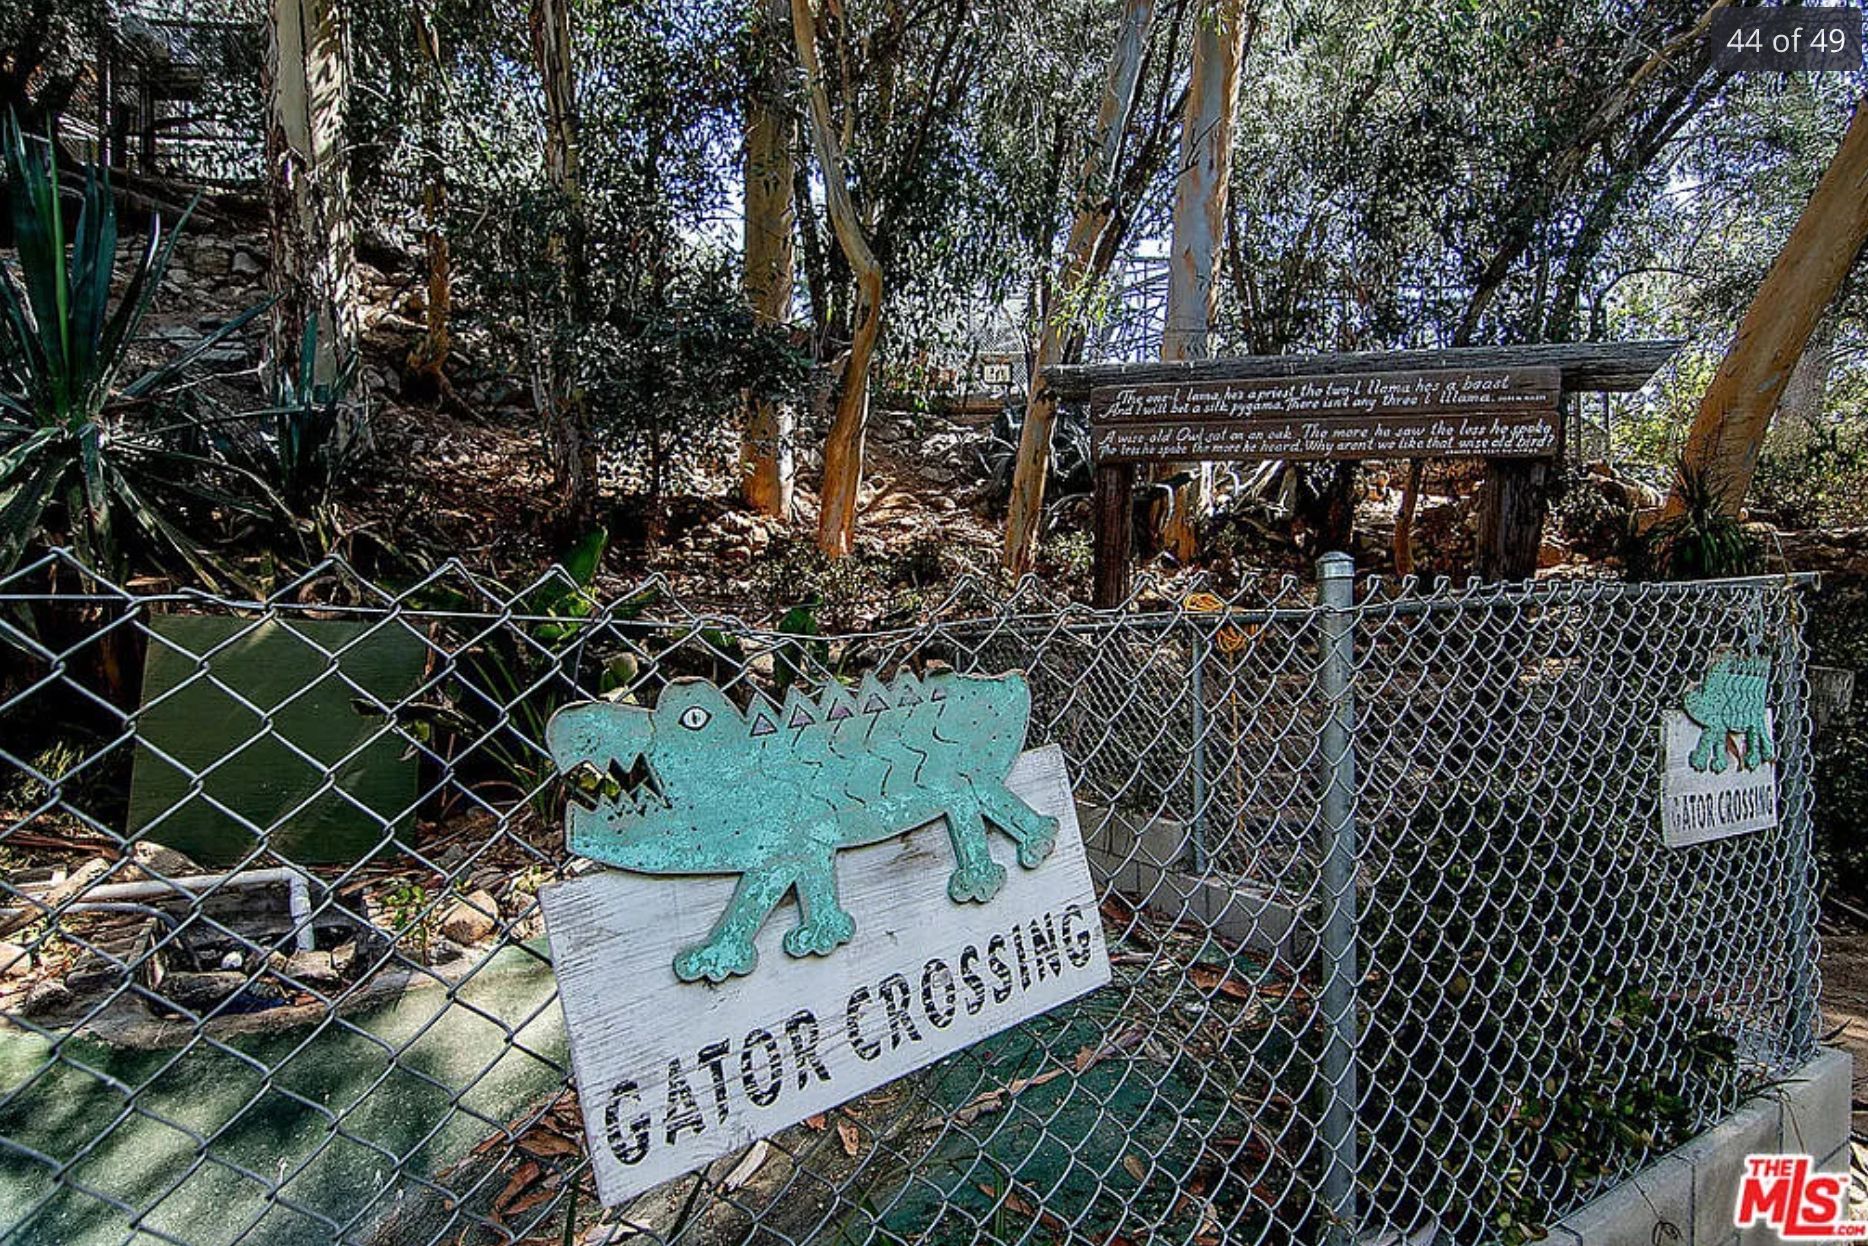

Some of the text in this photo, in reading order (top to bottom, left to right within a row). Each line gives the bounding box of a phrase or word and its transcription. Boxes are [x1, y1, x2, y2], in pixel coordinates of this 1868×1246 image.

[1116, 389, 1144, 404] The
[1300, 383, 1323, 398] the
[1367, 379, 1411, 396] llama
[1446, 382, 1458, 391] a
[1099, 401, 1134, 419] And
[1143, 402, 1168, 415] will
[1192, 404, 1202, 413] a
[1203, 399, 1229, 413] silk
[1352, 398, 1377, 412] any
[1098, 430, 1117, 445] A
[1149, 428, 1173, 443] old
[1176, 427, 1203, 445] Owl
[1204, 427, 1228, 443] sat
[1247, 431, 1264, 440] an
[1301, 423, 1330, 440] The
[1332, 427, 1369, 438] more
[1394, 426, 1426, 437] saw
[1431, 420, 1456, 436] the
[1490, 418, 1510, 435] he
[1212, 444, 1242, 454] more
[1242, 440, 1257, 453] he
[1304, 438, 1336, 457] Why
[1377, 440, 1396, 450] we
[1398, 436, 1424, 449] like
[1426, 436, 1454, 449] that
[1459, 436, 1490, 449] wise
[1490, 435, 1513, 448] old
[605, 904, 1092, 1166] GATOR CROSSING
